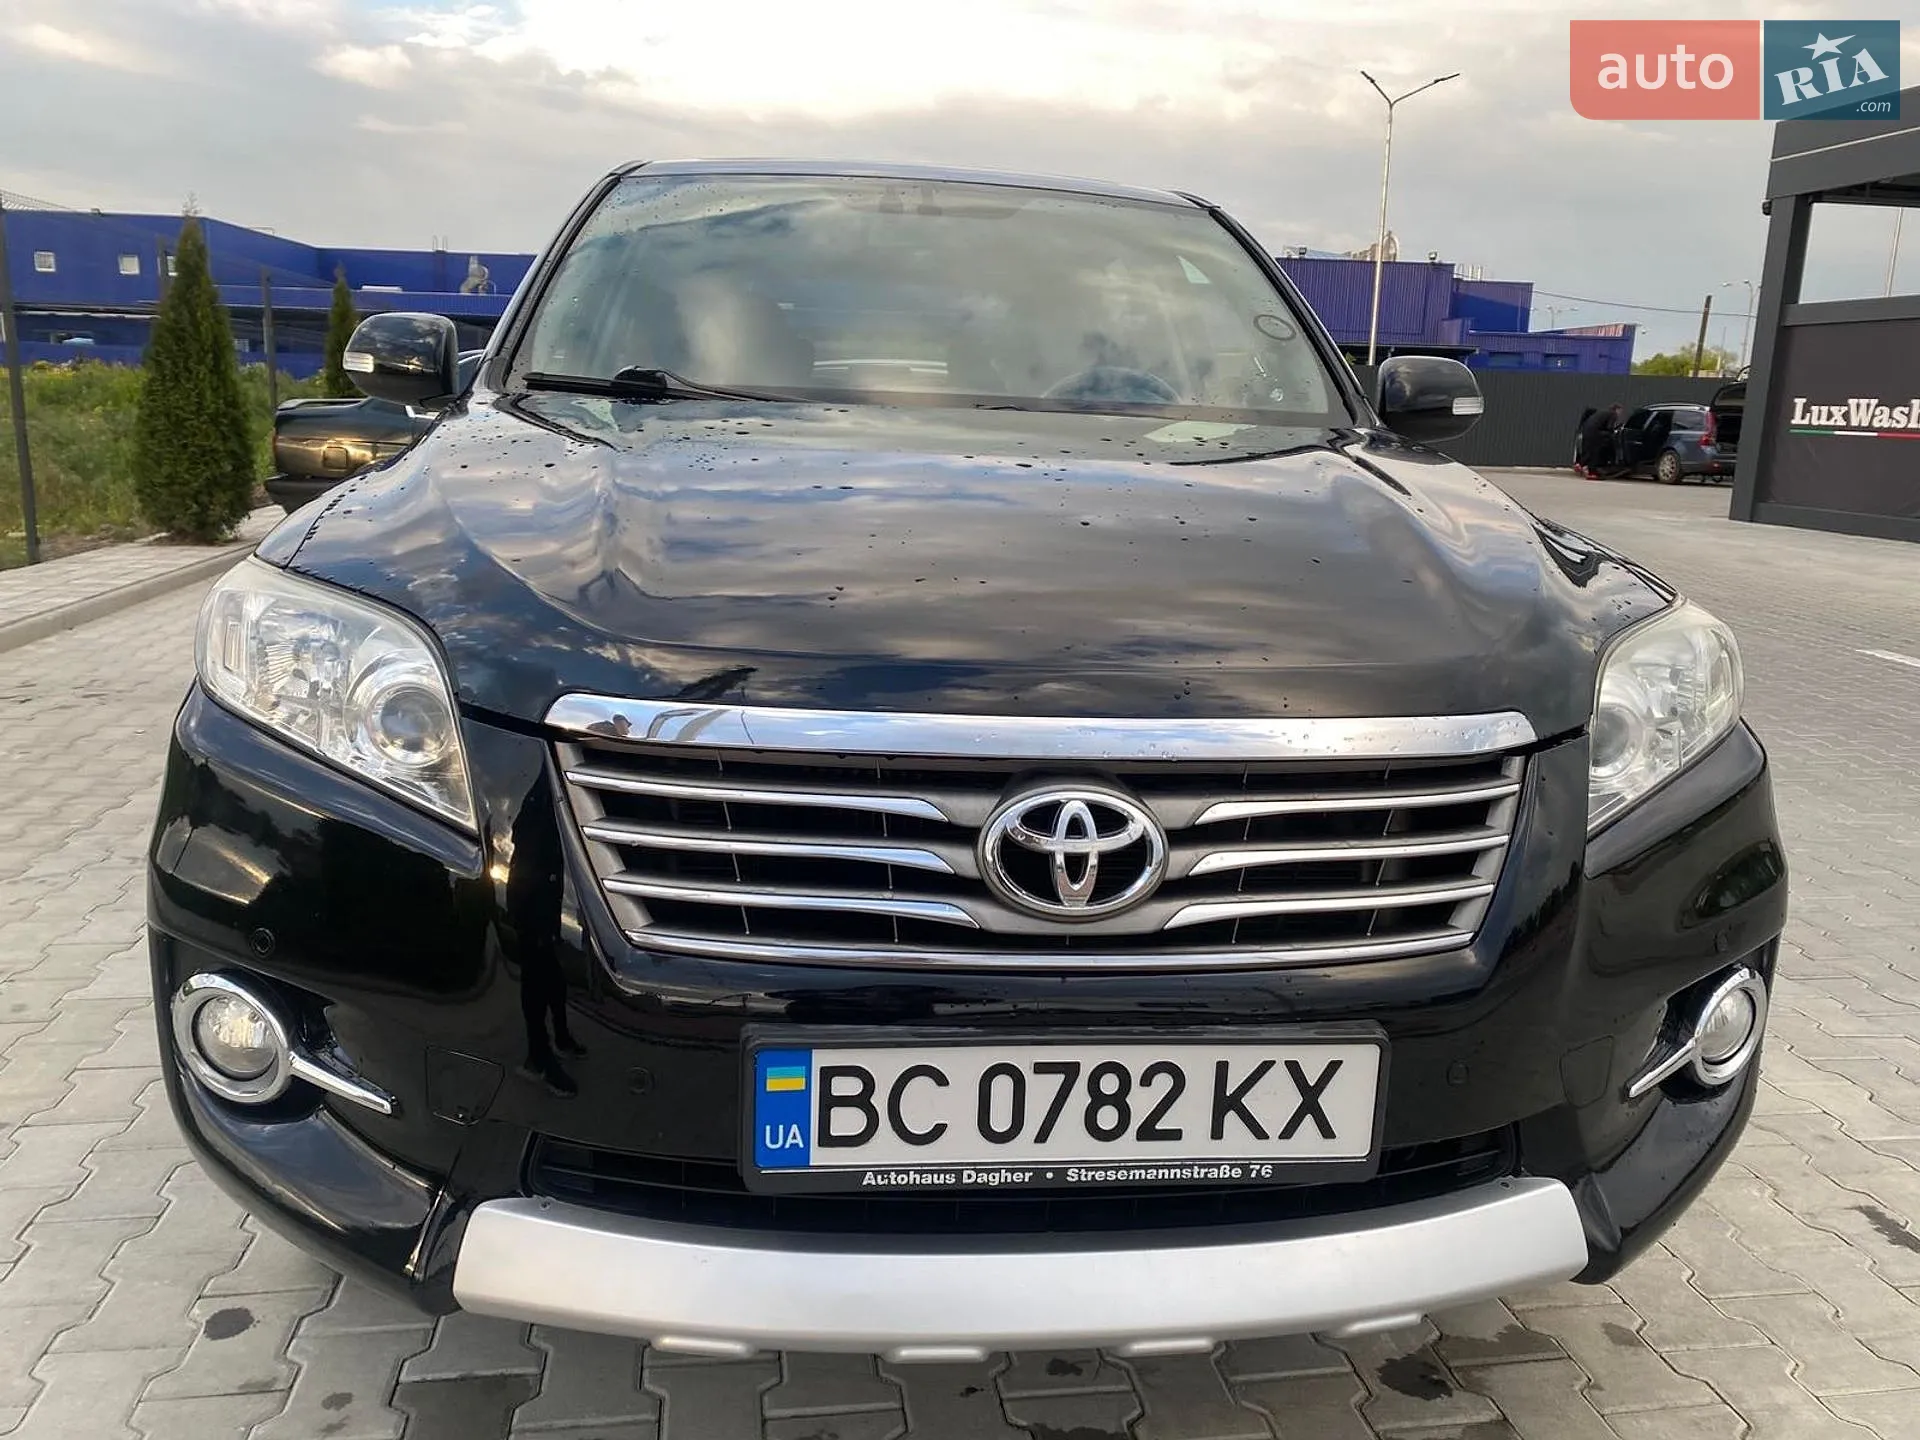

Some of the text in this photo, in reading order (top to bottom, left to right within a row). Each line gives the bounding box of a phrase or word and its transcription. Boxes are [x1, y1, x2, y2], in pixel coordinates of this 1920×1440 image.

[818, 1060, 1344, 1147] BC 0782 KX
[765, 1124, 804, 1149] UA
[862, 1164, 1273, 1187] Autohaus Dagher Stresemannstraße 76
